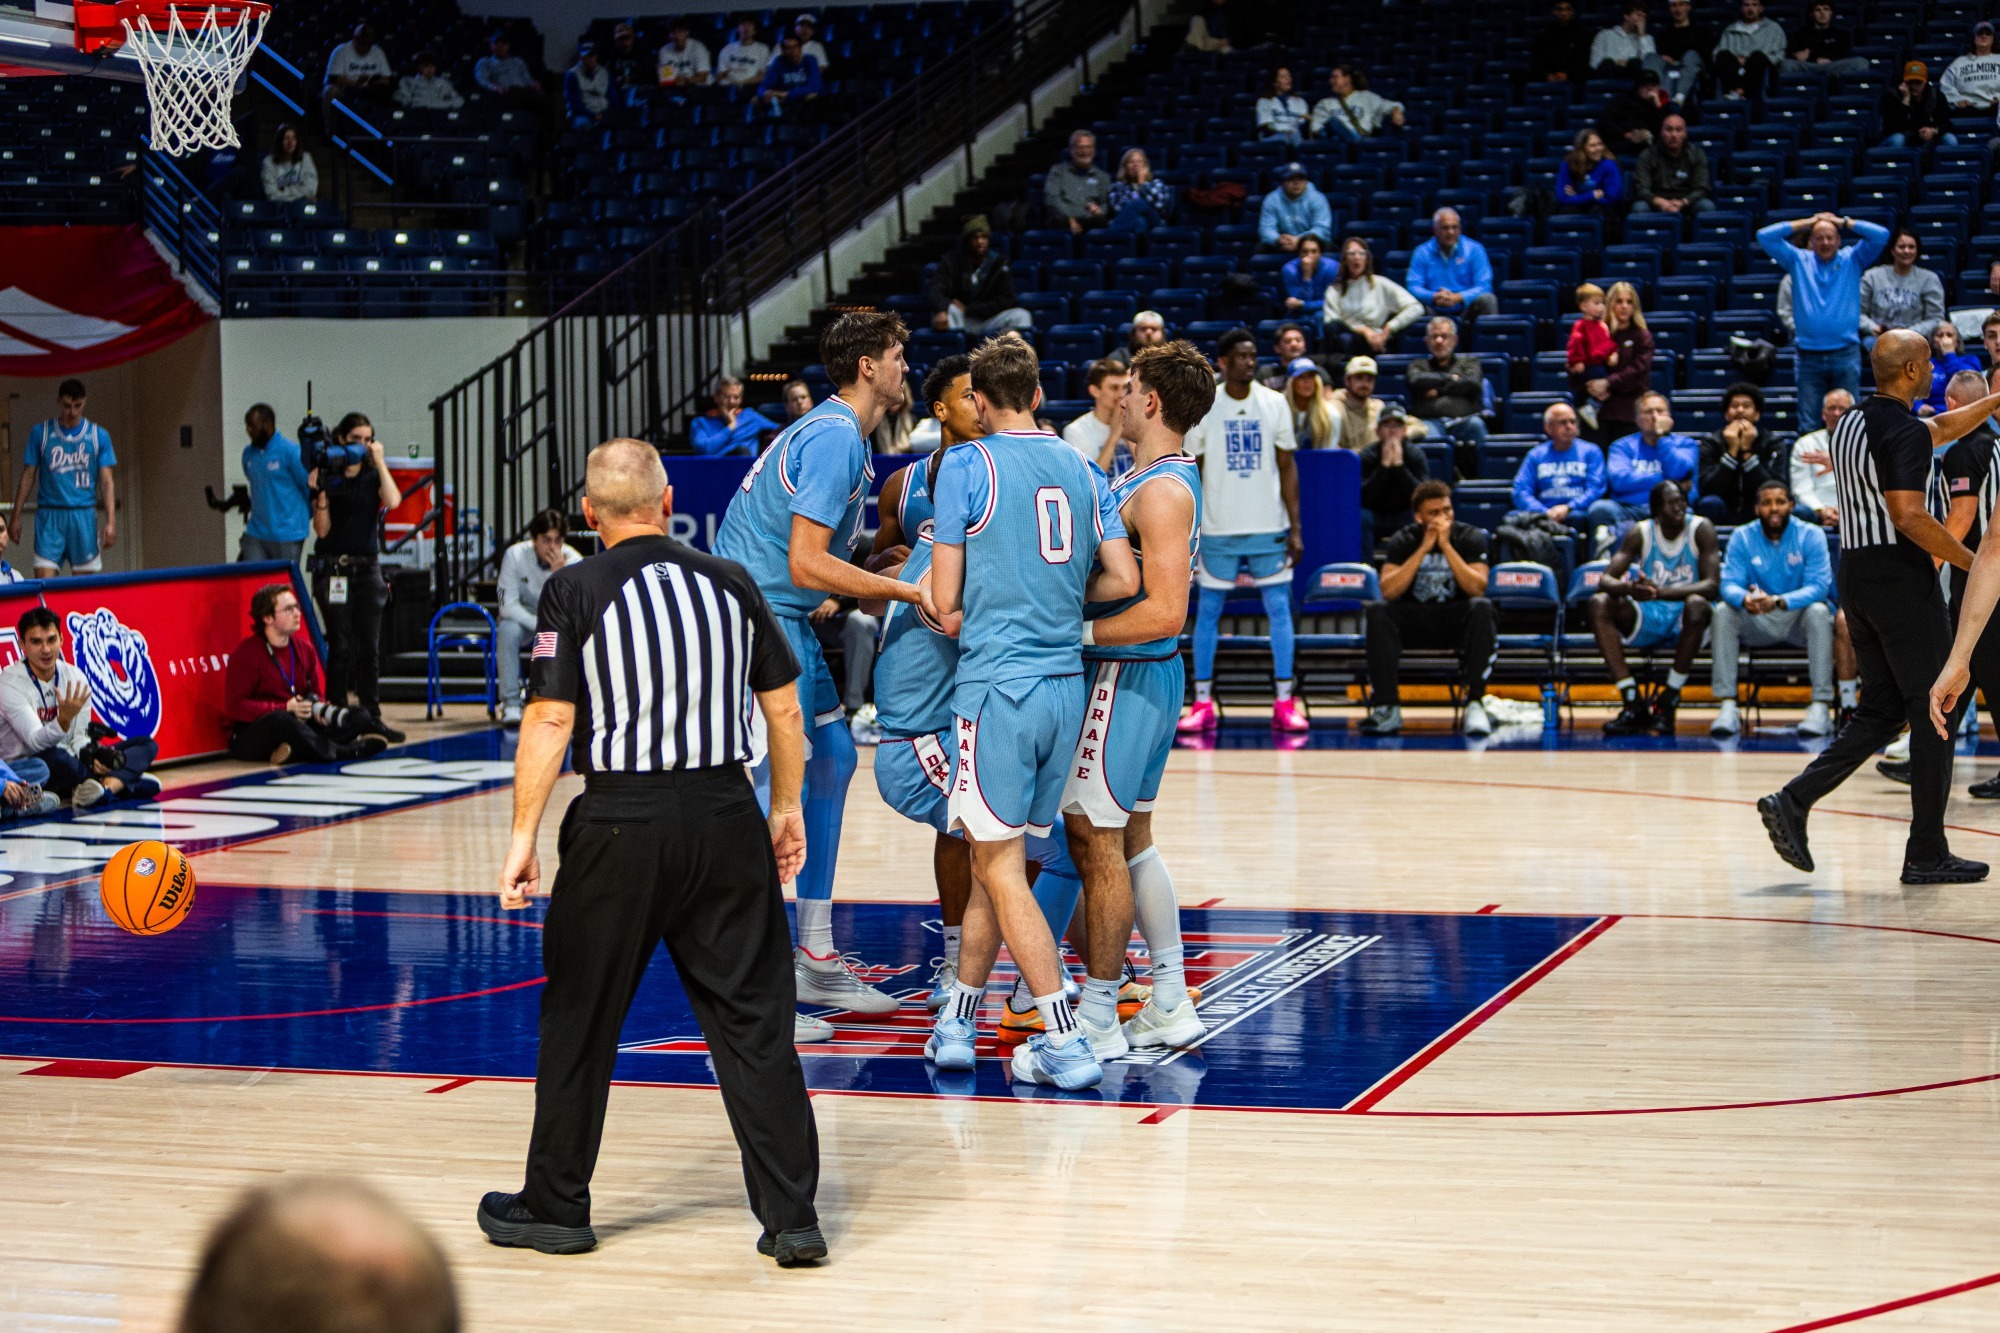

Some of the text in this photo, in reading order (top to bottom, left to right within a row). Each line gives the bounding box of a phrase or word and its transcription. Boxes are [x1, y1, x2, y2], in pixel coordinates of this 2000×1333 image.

[1226, 433, 1262, 453] IS NO
[1227, 453, 1261, 470] SECRET
[1035, 486, 1074, 564] 0
[958, 717, 973, 793] RAKE
[1076, 688, 1108, 780] DRAKE
[158, 855, 188, 910] Wilson
[1198, 984, 1281, 1015] VALLEY
[1255, 934, 1369, 984] CONFERENCE
